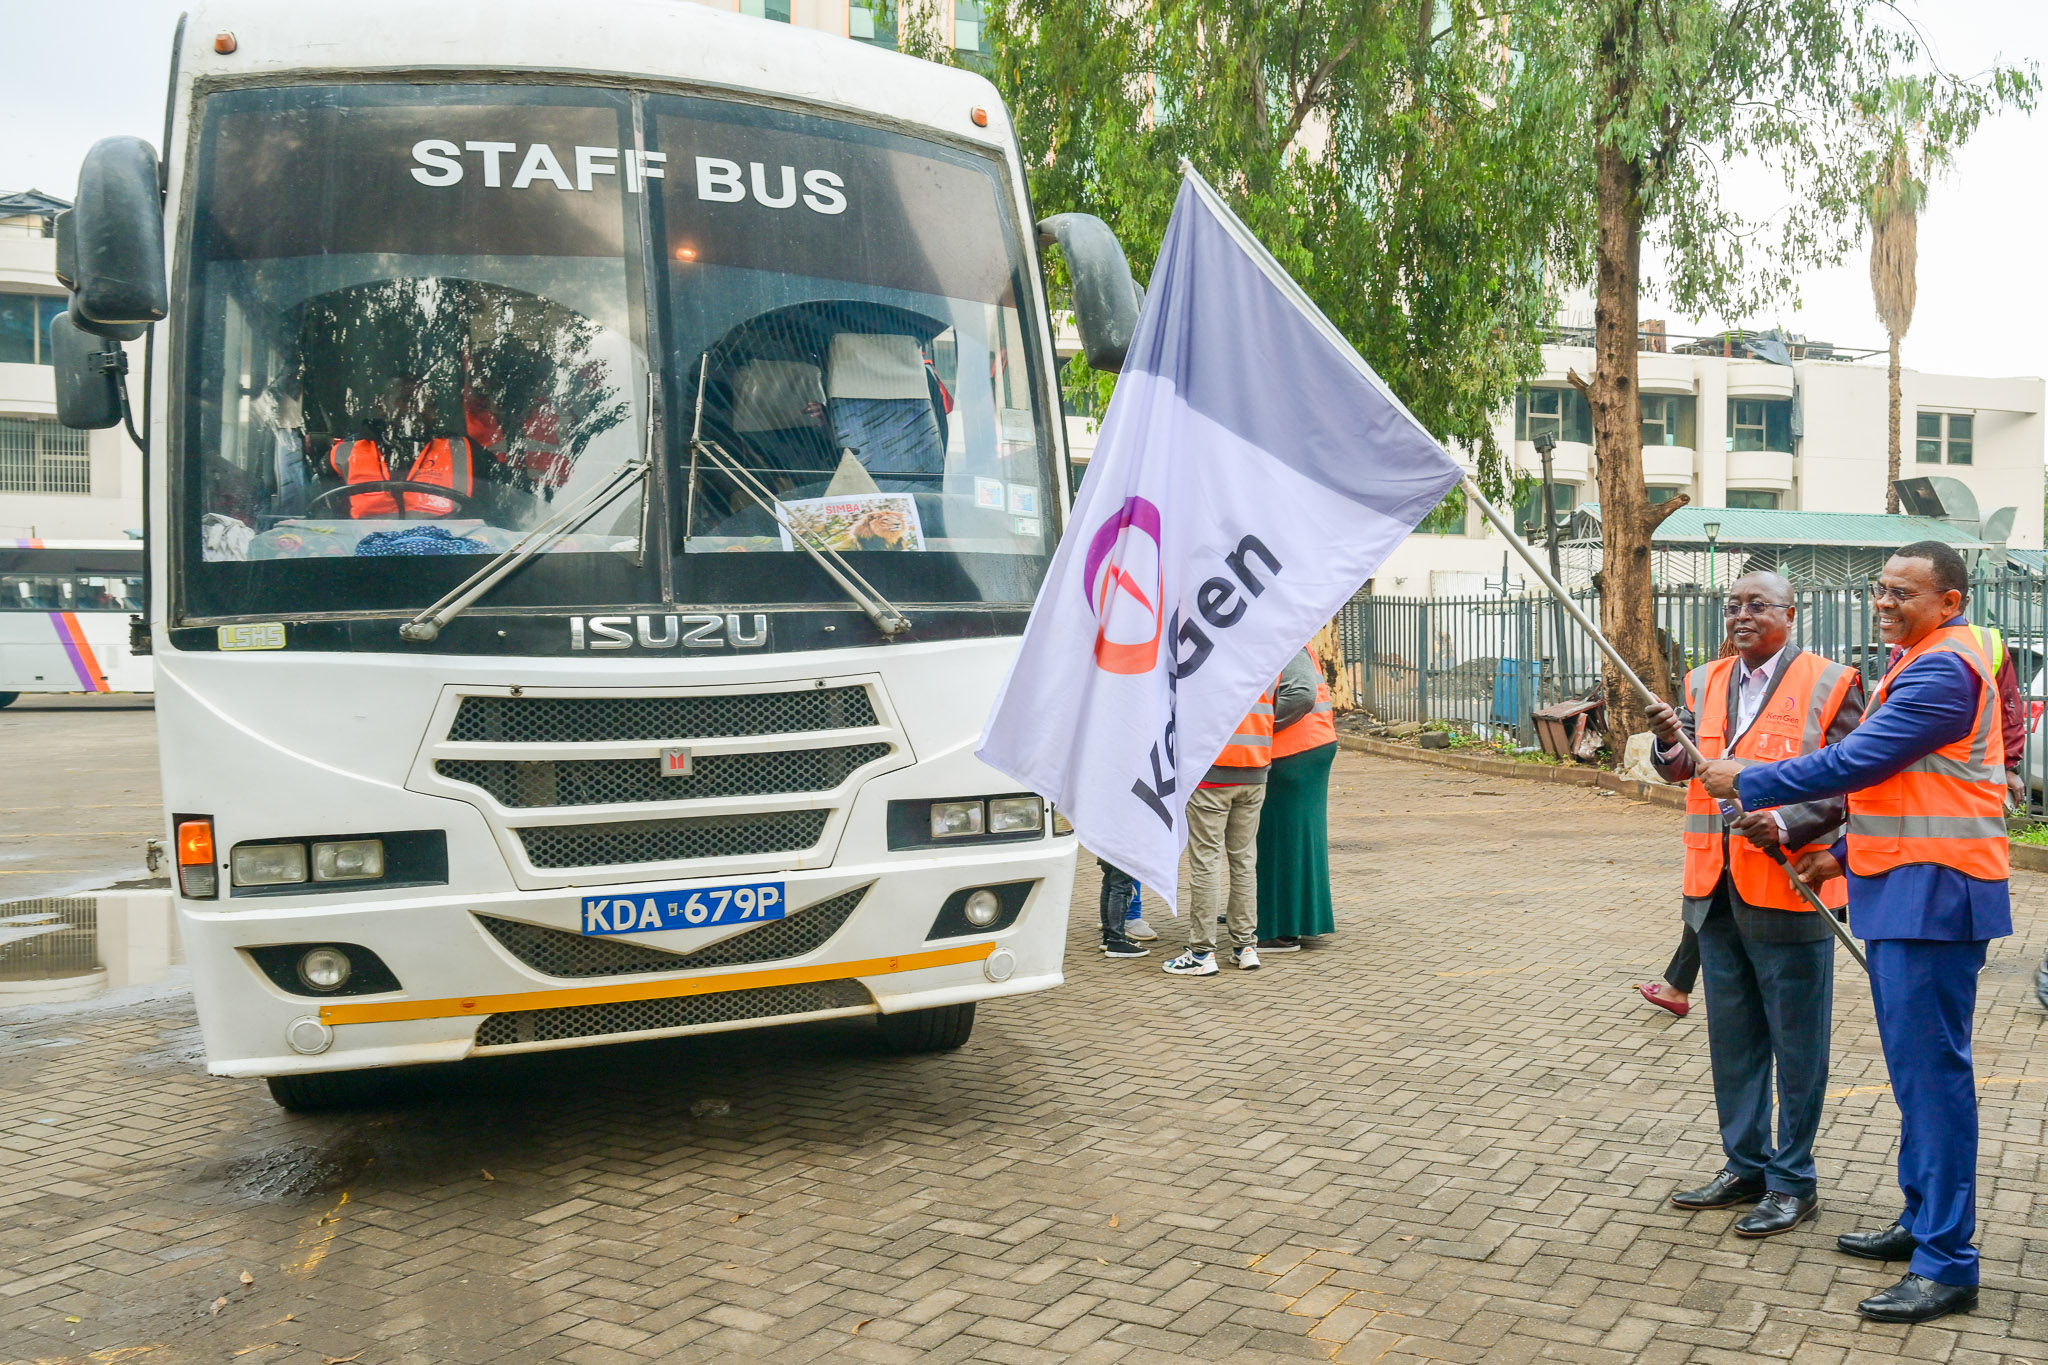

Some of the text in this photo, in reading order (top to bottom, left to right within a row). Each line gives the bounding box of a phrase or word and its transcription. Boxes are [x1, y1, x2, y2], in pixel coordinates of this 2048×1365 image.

[410, 139, 847, 215] STAFF BUS
[825, 503, 861, 514] SIMBA
[570, 614, 767, 650] ISUZU
[1131, 534, 1283, 832] KeGen
[1766, 711, 1800, 725] KenGen
[587, 886, 779, 932] KDA 679P
